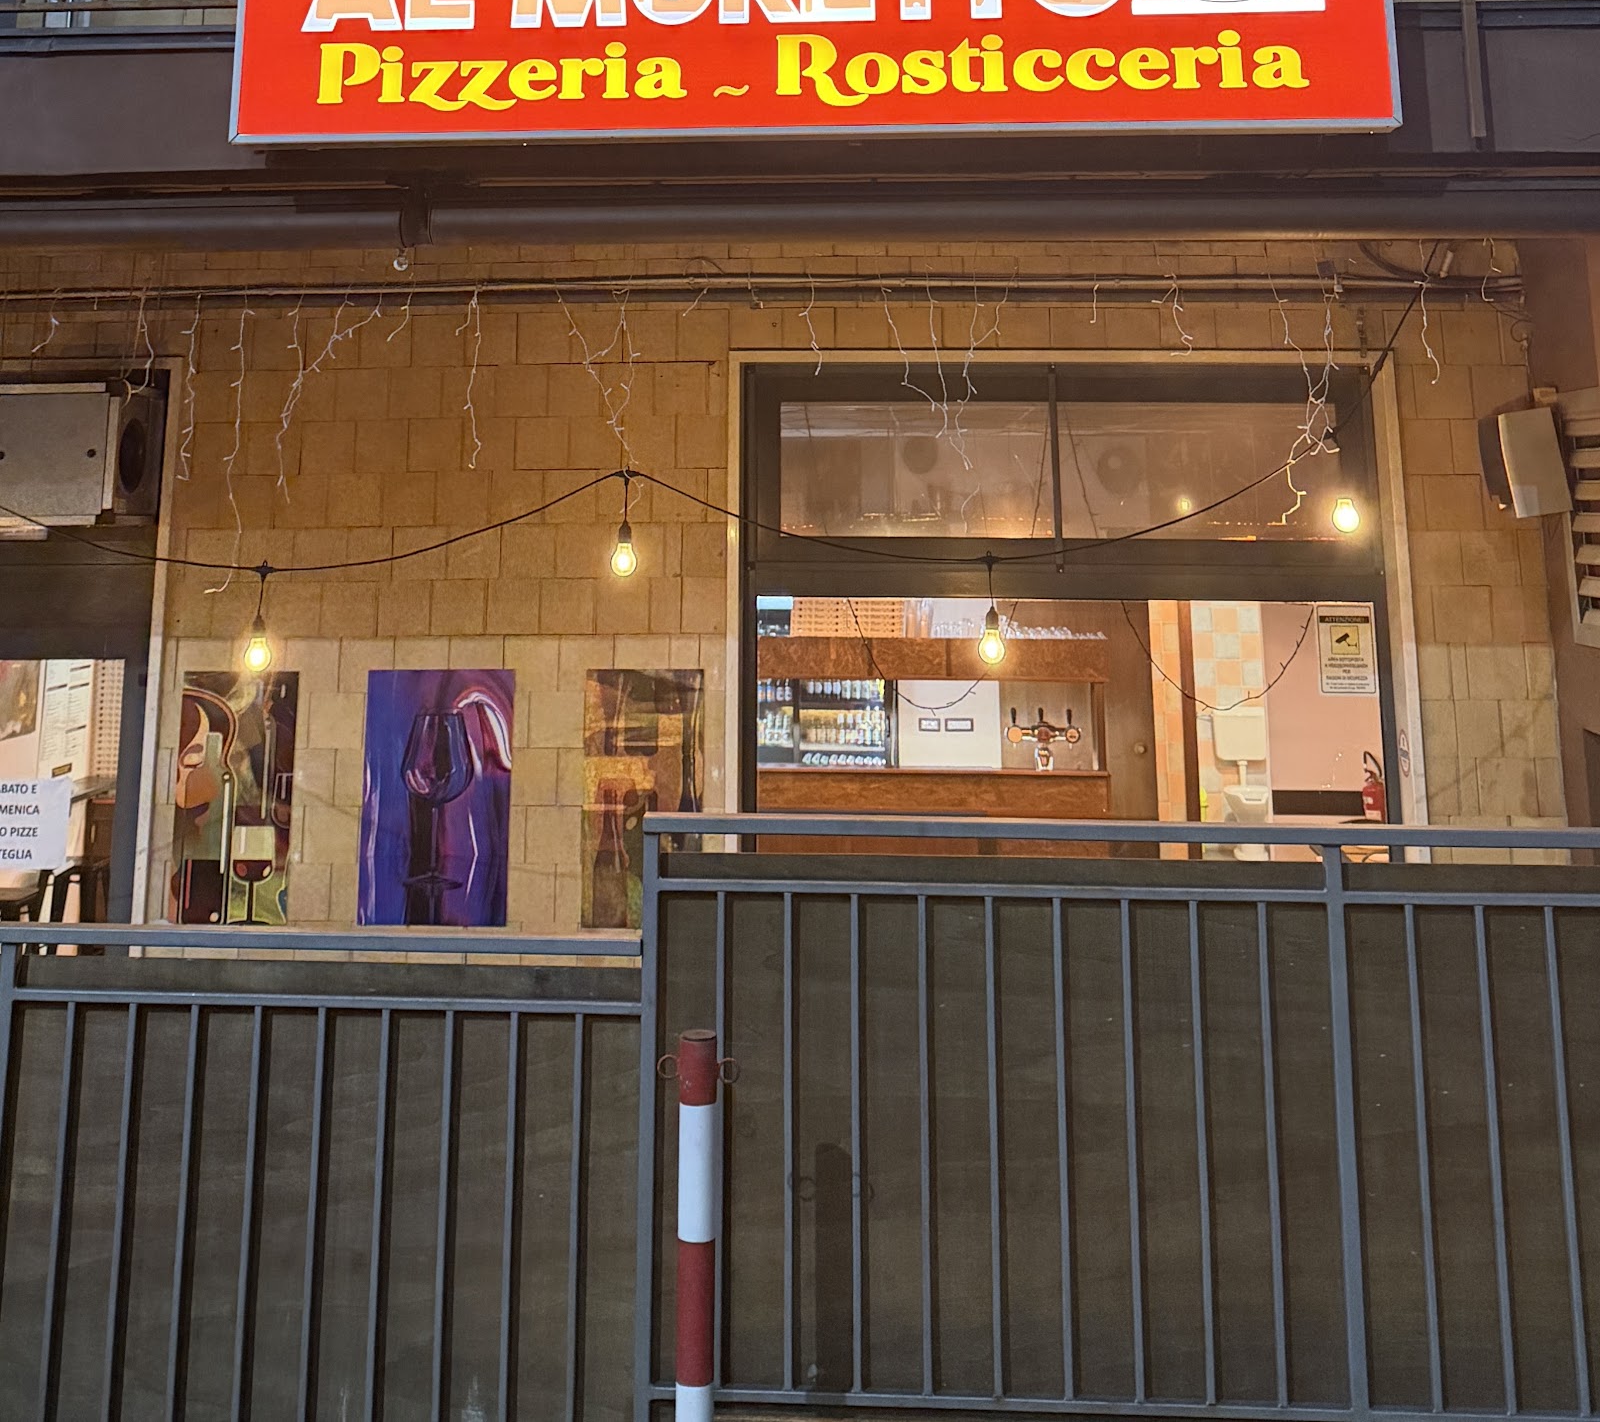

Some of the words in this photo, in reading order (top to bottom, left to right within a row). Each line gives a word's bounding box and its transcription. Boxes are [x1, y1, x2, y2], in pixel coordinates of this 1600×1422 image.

[316, 41, 689, 113] Pizzeria
[775, 29, 1311, 107] Rosticceria
[0, 784, 29, 794] BATO
[31, 784, 38, 794] E
[10, 826, 39, 837] PIZZE
